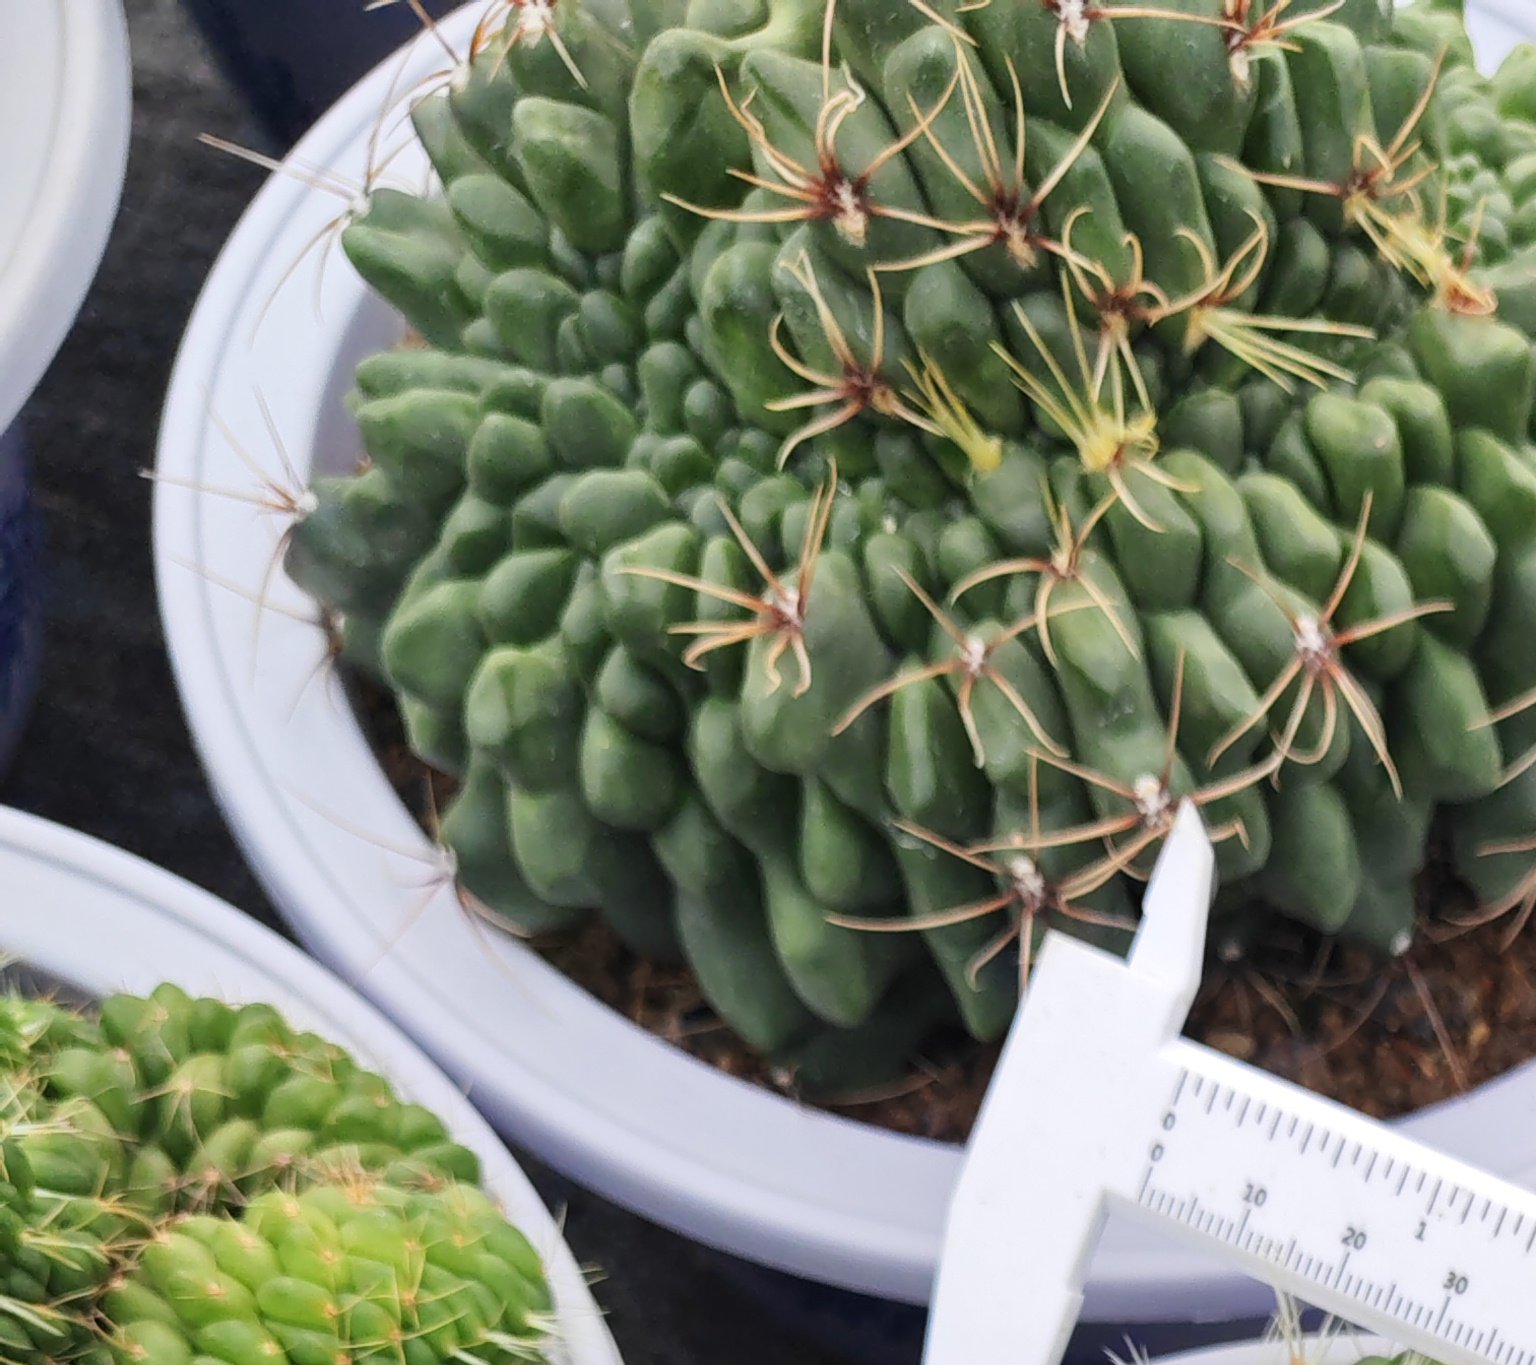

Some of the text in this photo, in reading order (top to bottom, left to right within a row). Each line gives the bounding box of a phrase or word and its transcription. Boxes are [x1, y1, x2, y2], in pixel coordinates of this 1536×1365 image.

[1150, 1143, 1165, 1162] 0
[1242, 1182, 1268, 1207] 10
[1341, 1226, 1367, 1250] 20
[1442, 1270, 1469, 1295] 30
[1161, 1111, 1176, 1131] 0
[1414, 1220, 1427, 1242] 1
